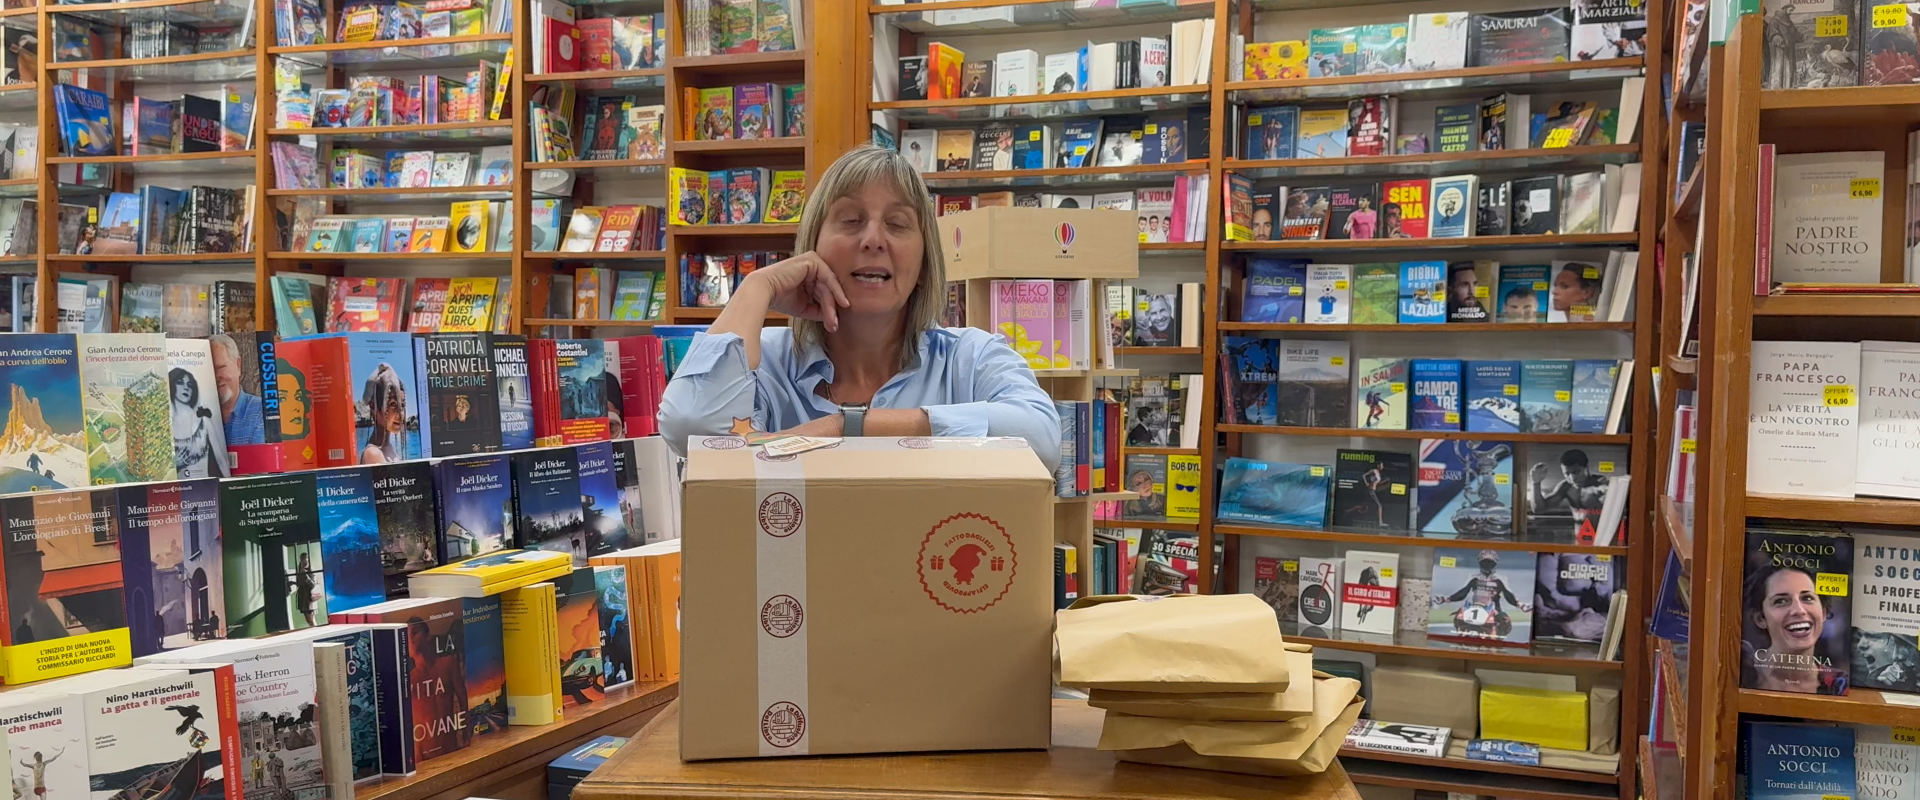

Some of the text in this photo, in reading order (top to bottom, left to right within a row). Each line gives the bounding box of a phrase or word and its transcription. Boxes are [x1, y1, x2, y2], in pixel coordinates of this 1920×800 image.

[1582, 7, 1641, 19] MARZIALI
[1481, 17, 1537, 31] SAMURAI
[1880, 18, 1896, 26] 9,90
[68, 89, 104, 110] CARAIBI
[1442, 127, 1467, 136] NIENTE
[1441, 136, 1458, 144] TESTE
[1851, 179, 1879, 187] OFFERTA
[1149, 189, 1172, 202] VOLO
[1332, 192, 1350, 200] CARLOS
[1389, 187, 1421, 203] SEN
[1859, 190, 1873, 198] 6,90
[1332, 199, 1356, 207] ALCARAZ
[1401, 202, 1424, 219] NA
[1283, 217, 1321, 228] DIVENTARE
[1281, 226, 1320, 238] SINNER
[1796, 226, 1859, 239] PADRE
[1785, 242, 1869, 256] NOSTRO
[1408, 266, 1439, 281] BIBBIA
[1252, 275, 1301, 287] PADEL
[1000, 284, 1049, 297] MIEKO
[1000, 296, 1049, 304] KAWAKAMI
[1401, 301, 1445, 316] LAZIALE
[445, 315, 476, 327] LIBRO
[10, 348, 72, 357] Andrea Cerone
[87, 345, 162, 354] Gian Andrea Cerone
[428, 340, 485, 357] PATRICIA
[556, 343, 581, 351] Roberto
[556, 349, 588, 357] Costantini
[1287, 348, 1319, 357] BIKE LIFE
[86, 354, 165, 363] L'incertezza del domani
[181, 349, 206, 359] Canepa
[31, 356, 67, 365] dell'oblio
[1415, 363, 1437, 371] MATTIA
[1783, 362, 1820, 372] PAPA
[260, 342, 280, 410] CUSSLER
[429, 375, 487, 389] TRUE CRIME
[1756, 373, 1847, 384] FRANCESCO
[1414, 381, 1458, 396] CAMPO
[1824, 387, 1855, 395] OFFERTA
[1436, 395, 1458, 411] TRE
[1768, 404, 1783, 412] LA
[1833, 398, 1849, 406] 6,90
[1760, 413, 1850, 426] UN INCONTRO
[1758, 427, 1784, 436] Omelie
[1797, 429, 1816, 438] Santa
[1817, 430, 1840, 438] Marta
[1876, 424, 1908, 434] CHE
[1872, 437, 1899, 449] GLI
[1341, 452, 1376, 464] running
[534, 459, 566, 471] Joël Dicker
[579, 459, 605, 471] Joël Dicker
[1171, 462, 1185, 471] BOB
[389, 477, 416, 488] Dicker
[460, 474, 499, 486] Joël Dicker
[327, 486, 355, 497] Dicker
[240, 496, 294, 512] Joël Dicker
[336, 496, 369, 506] camera 622
[402, 493, 423, 503] Quebert
[127, 498, 216, 516] Maurizio de Giovanni
[247, 508, 289, 518] La scomparsa
[9, 508, 111, 529] Maurizio de Giovanni
[128, 511, 217, 528] Il tempo dell'orologiaio
[247, 516, 278, 527] Stephanie
[13, 523, 110, 543] L'orologiaio di Brest
[944, 532, 996, 552] FATTO DAGLI ELFI
[1153, 541, 1165, 552] SO
[1758, 539, 1836, 556] ANTONIO
[1771, 554, 1821, 569] SOCCI
[1568, 563, 1609, 574] GIOCHI
[1560, 570, 1609, 581] OLIMPICI
[1817, 575, 1847, 583] OFFERTA
[942, 581, 975, 597] APPROVED
[1347, 587, 1392, 600] IL GIRO d'ITALIA
[1825, 586, 1840, 594] 5,90
[1863, 584, 1878, 596] LA
[1470, 608, 1478, 621] 1
[1879, 602, 1920, 615] FINALE
[40, 645, 65, 656] L'INIZIO
[89, 639, 111, 648] NUOVA
[435, 634, 455, 654] LA
[36, 645, 116, 664] STORIA PER L'AUTORE DEL
[1754, 648, 1833, 667] CATERINA
[37, 652, 116, 672] COMMISSARIO RICCIARDI
[254, 668, 290, 680] Herron
[106, 680, 194, 705] Nino Haratischwili
[250, 682, 288, 693] Country
[101, 706, 112, 715] La
[114, 700, 140, 714] gatta
[151, 695, 158, 705] il
[160, 690, 200, 705] generale
[8, 718, 62, 735] che manca
[1901, 734, 1916, 743] 5,90
[1364, 743, 1392, 751] LEGGENDE
[1410, 746, 1429, 754] SPORT
[1767, 743, 1841, 759] ANTONIO
[1778, 761, 1827, 774] SOCCI
[1765, 779, 1842, 792] Tornati dall'Aldilà
